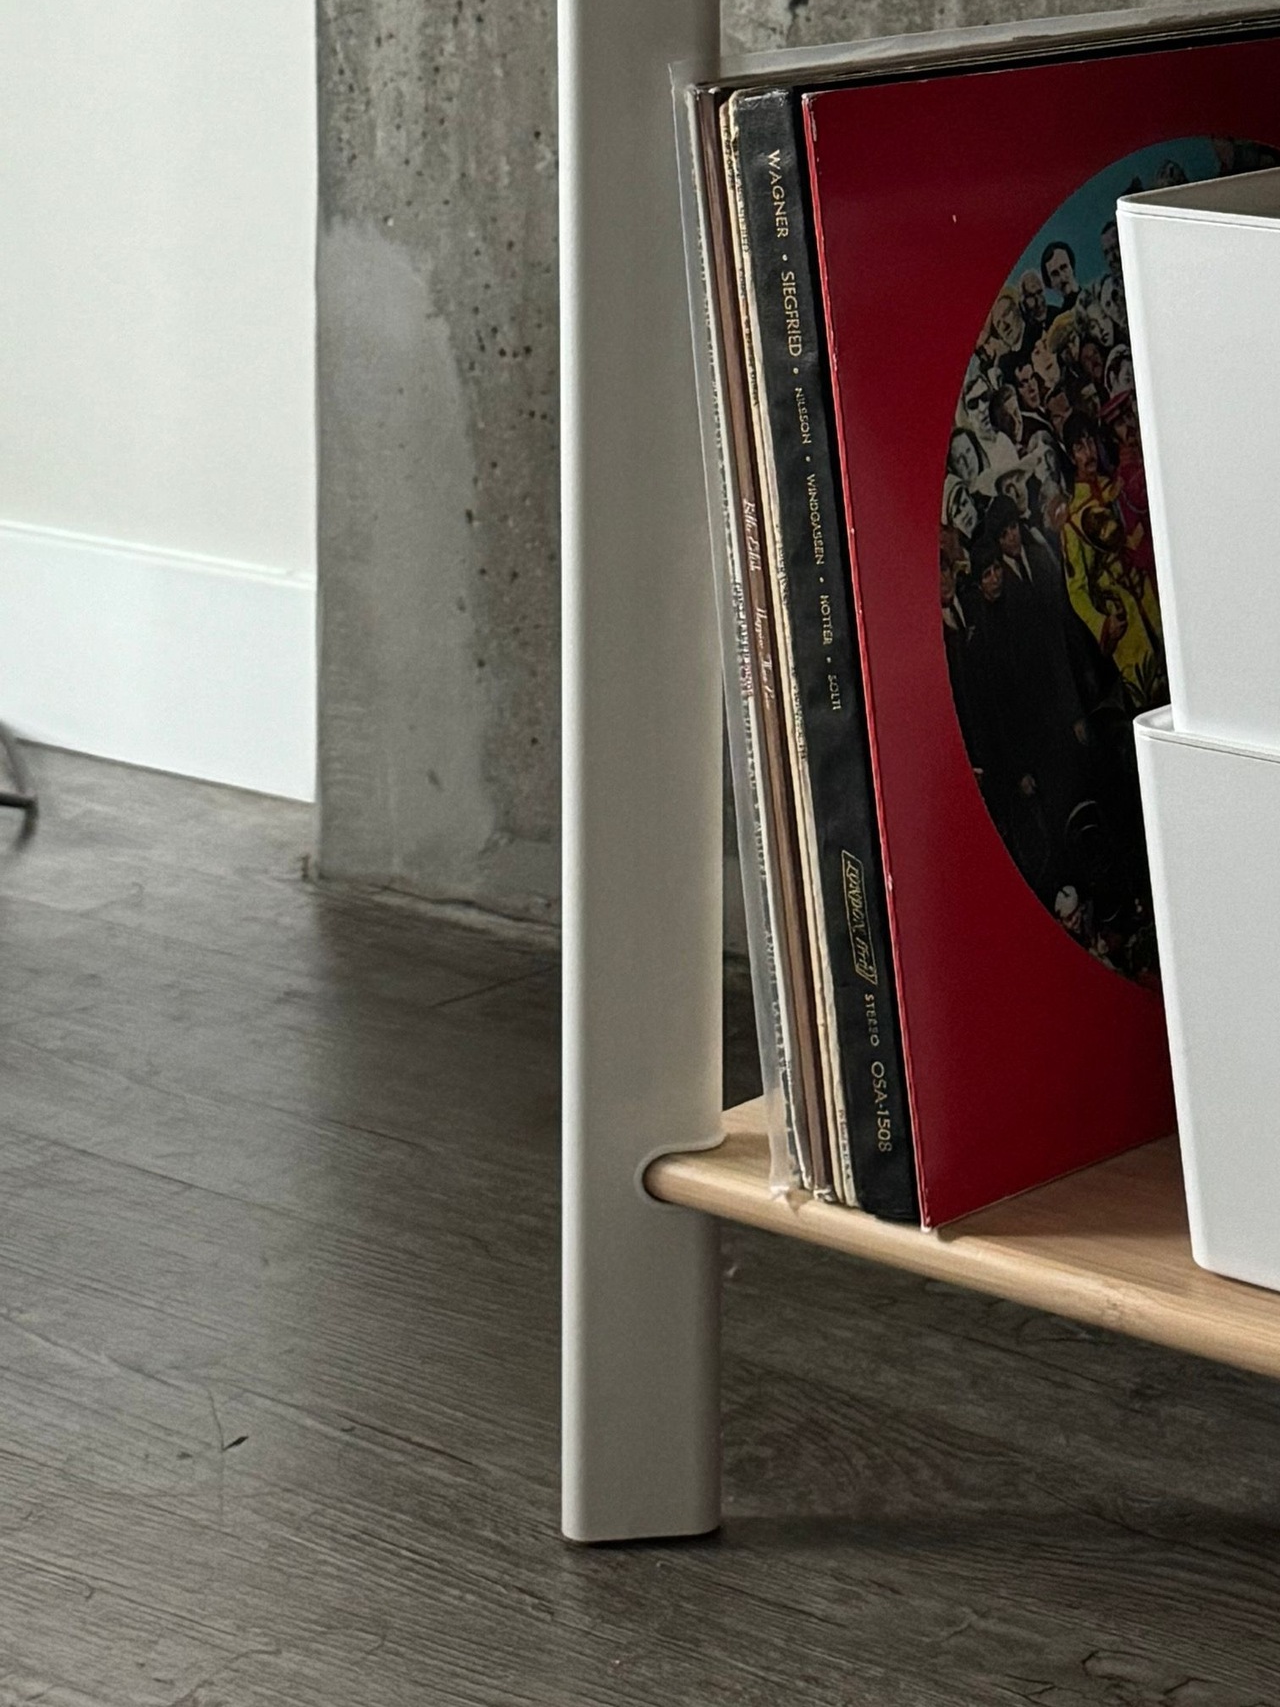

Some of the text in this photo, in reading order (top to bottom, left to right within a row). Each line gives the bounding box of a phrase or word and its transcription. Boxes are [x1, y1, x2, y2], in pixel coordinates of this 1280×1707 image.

[767, 149, 842, 711] WAGNER SIEGFRIED NILSSON WINDGASSEN HOTTER SOLTI
[864, 993, 881, 1047] STEREO
[870, 1060, 893, 1153] OSA-1508
